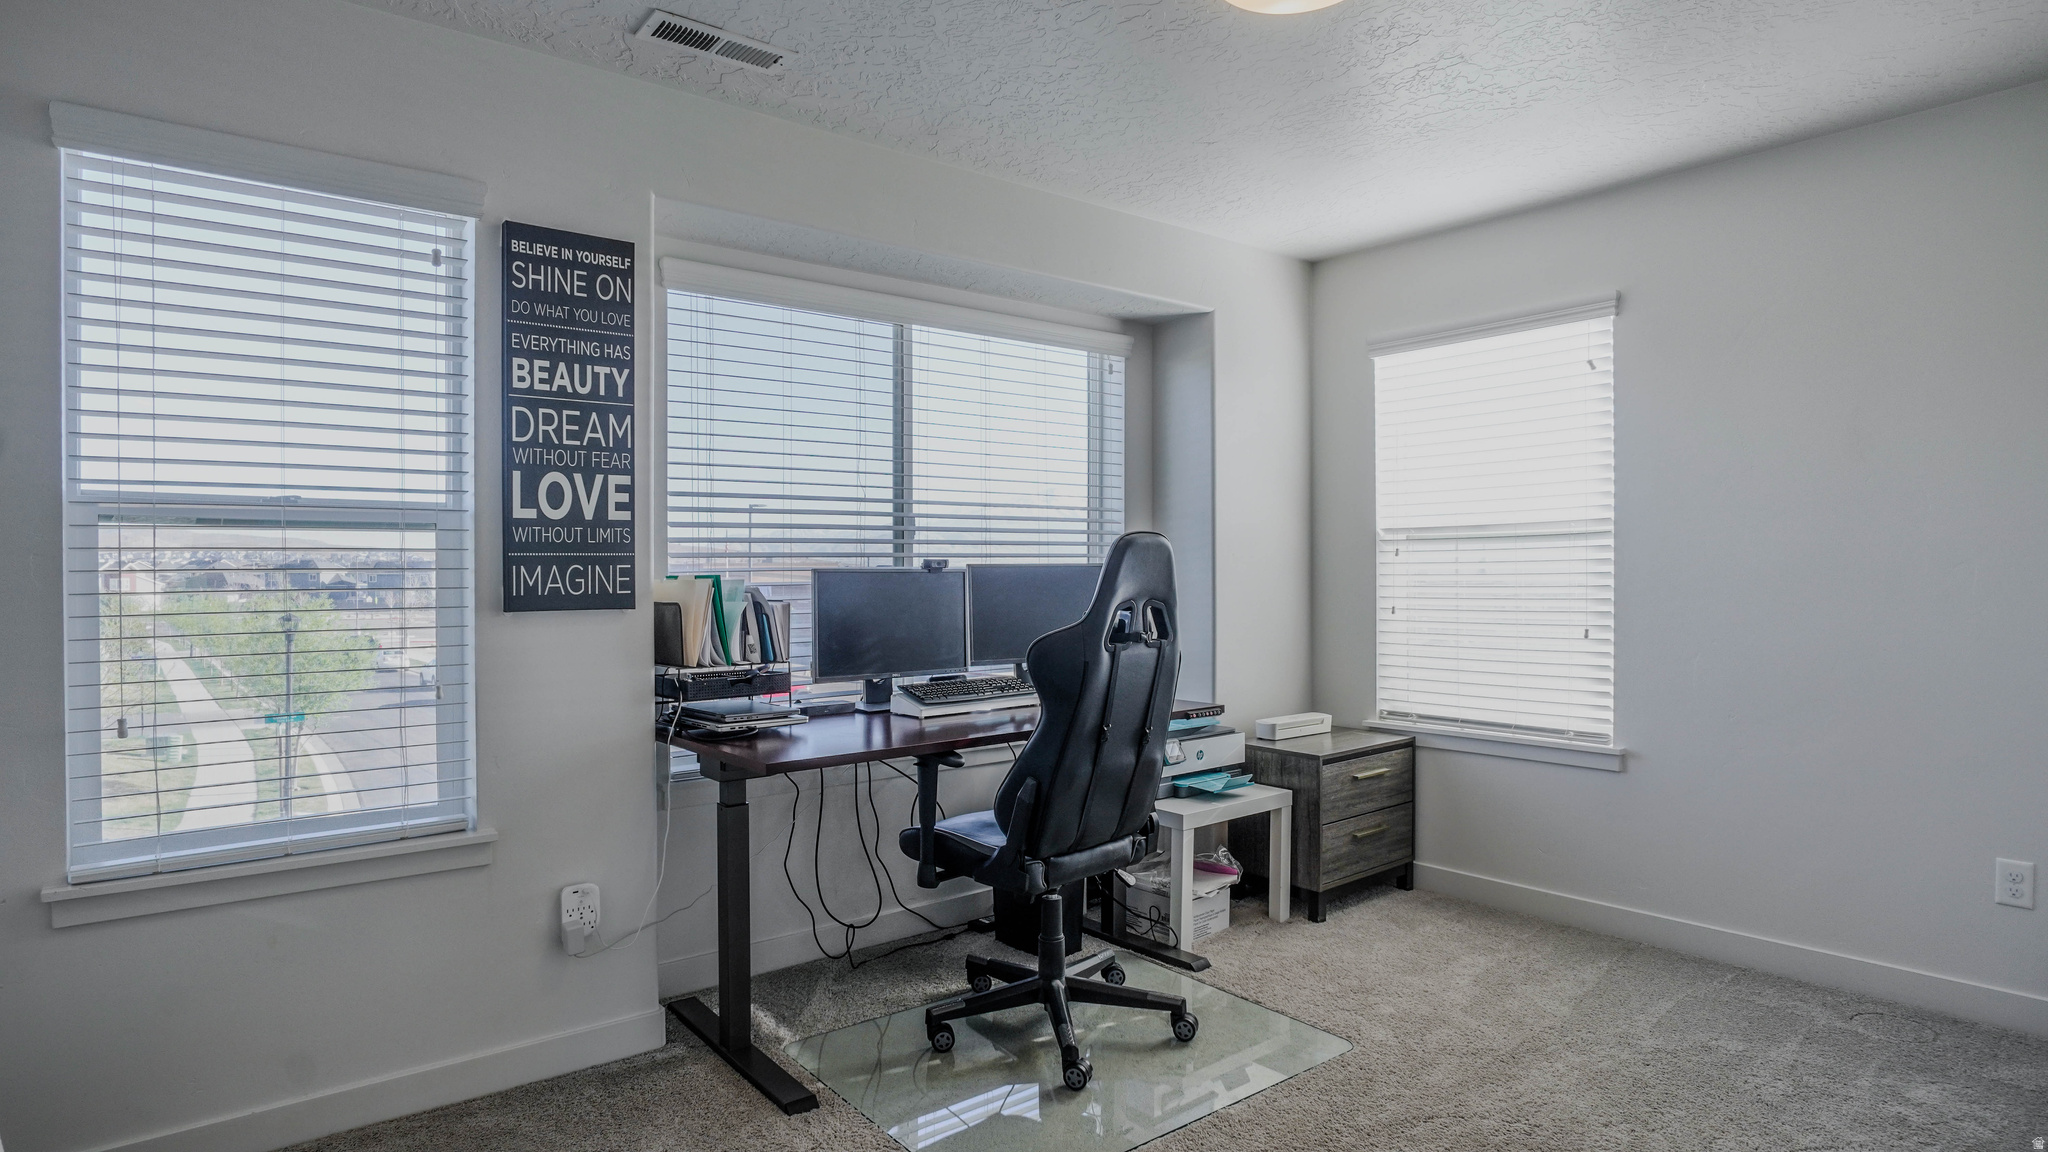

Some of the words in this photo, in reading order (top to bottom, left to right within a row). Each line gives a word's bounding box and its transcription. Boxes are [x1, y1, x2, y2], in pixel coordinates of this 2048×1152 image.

[512, 239, 558, 258] BELIEVE
[561, 247, 573, 261] IN
[576, 250, 631, 269] YOURSELF
[511, 260, 588, 298] SHINE
[596, 273, 632, 304] ON
[511, 299, 530, 315] DO
[534, 302, 570, 320] WHAT
[573, 308, 598, 323] YOU
[601, 311, 631, 328] LOVE
[511, 333, 600, 357] EVERYTHING
[604, 343, 631, 361] HAS
[512, 357, 630, 398] BEAUTY
[512, 405, 632, 448] DREAM
[512, 447, 587, 467] WITHOUT
[591, 451, 631, 469] FEAR
[512, 470, 632, 521] LOVE
[512, 526, 583, 543] WITHOUT
[587, 527, 631, 544] LIMITS
[512, 564, 631, 596] IMAGINE
